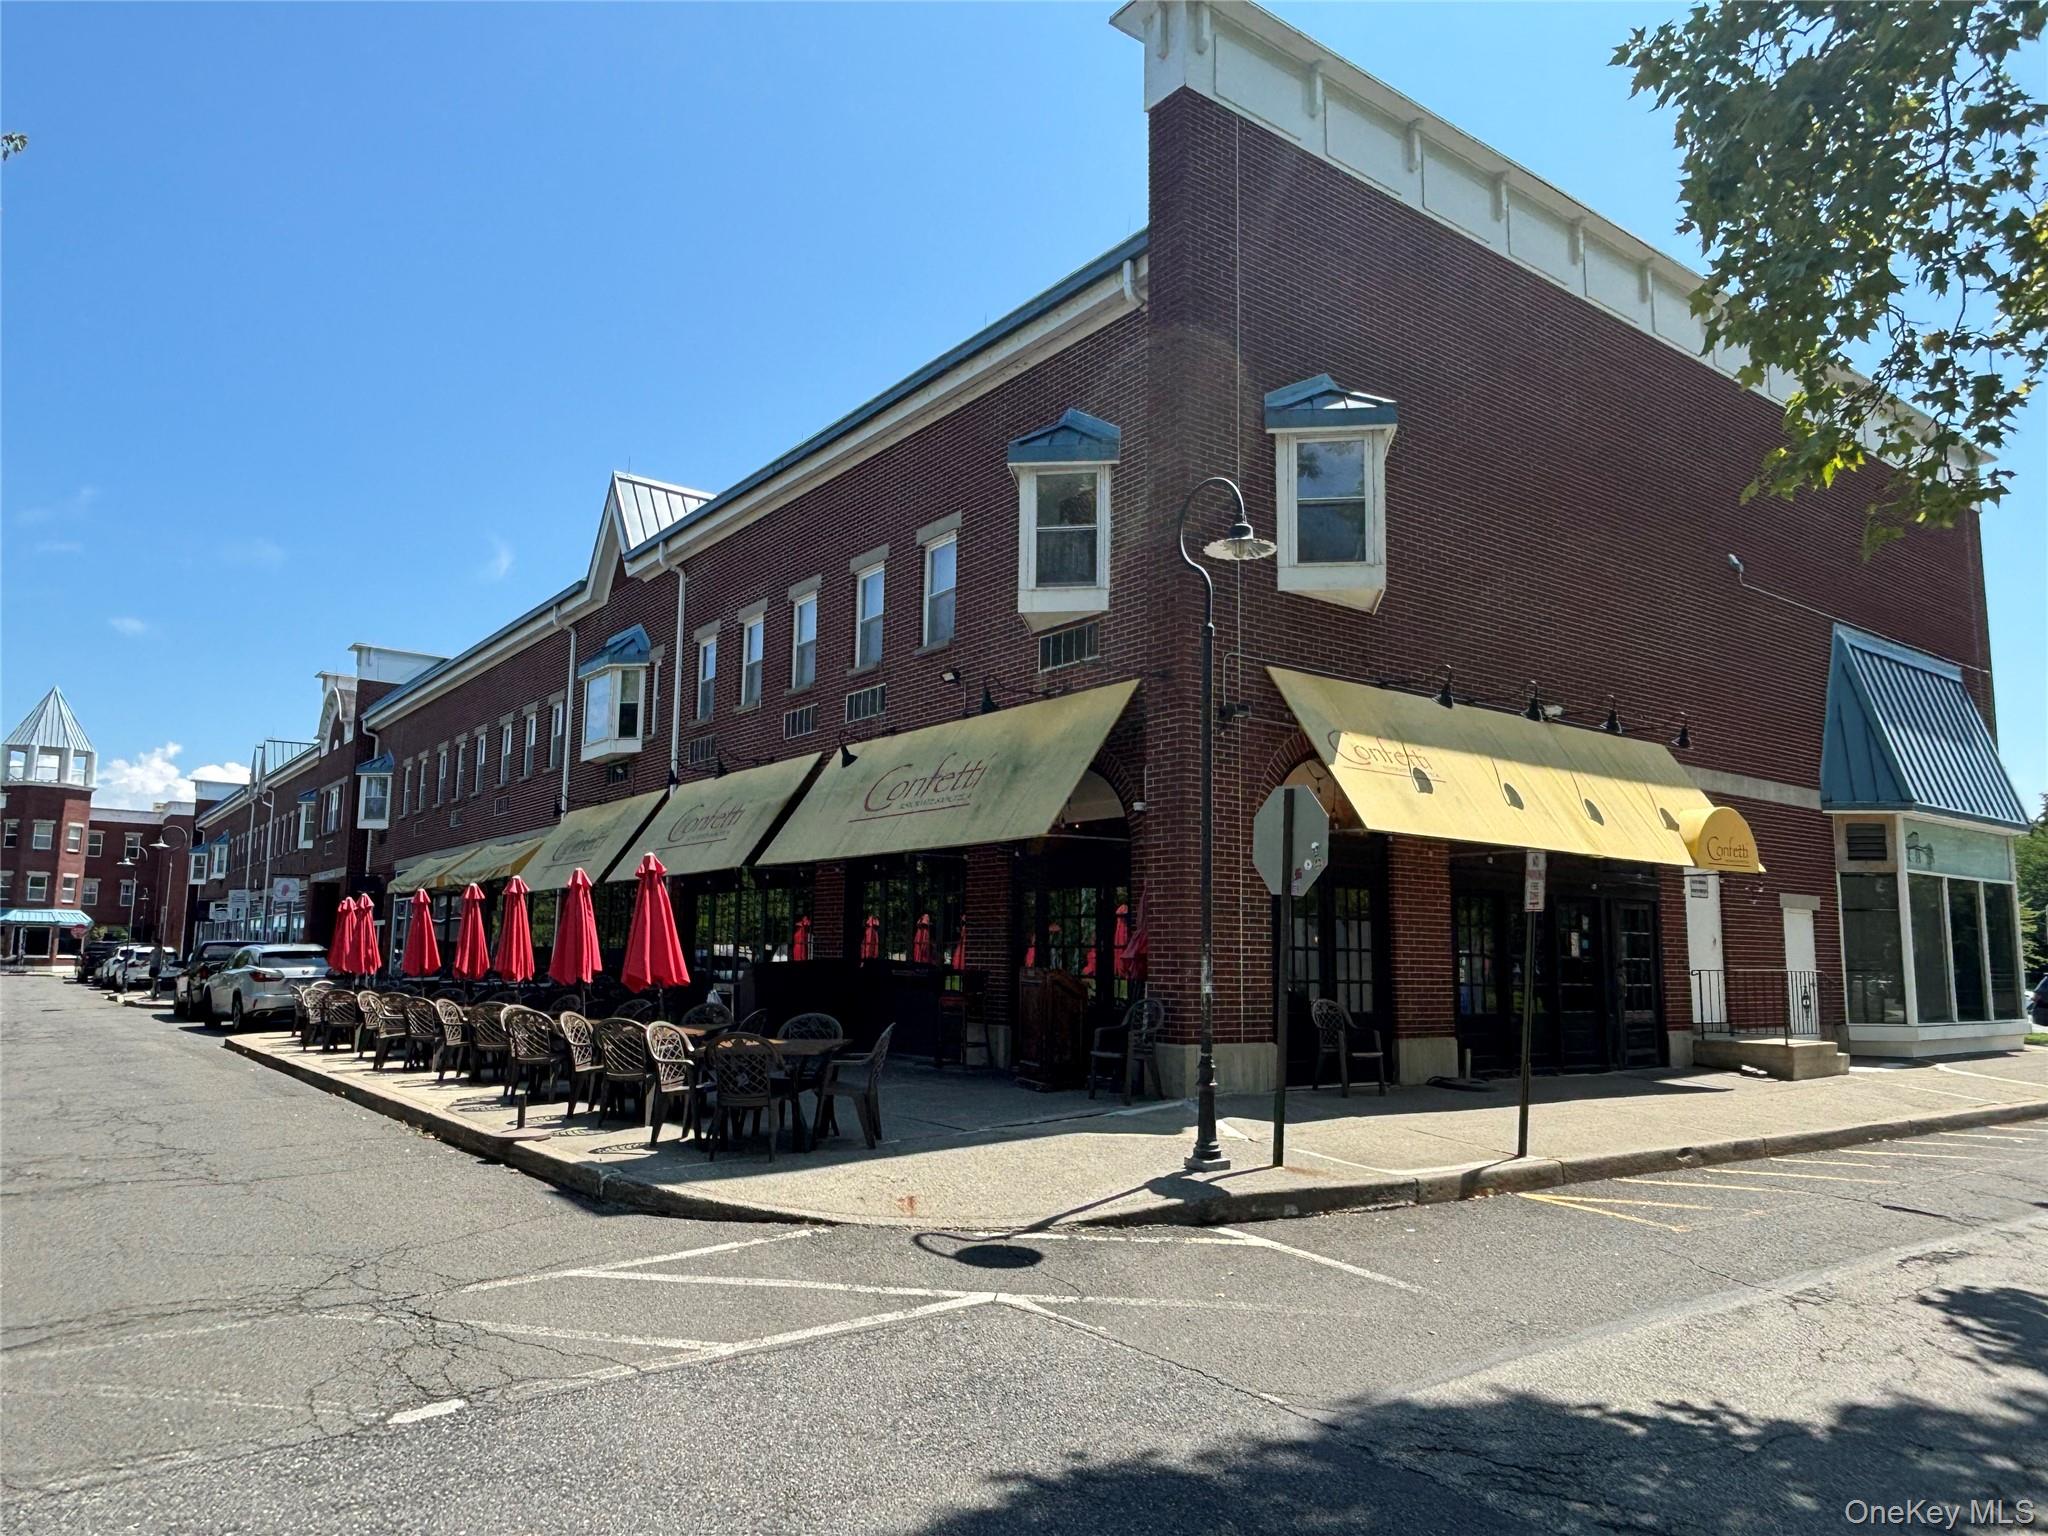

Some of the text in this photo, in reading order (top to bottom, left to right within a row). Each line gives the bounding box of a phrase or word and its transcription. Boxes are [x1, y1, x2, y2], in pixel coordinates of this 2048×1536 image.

[1327, 730, 1434, 770] Confetti
[863, 751, 999, 812] Confetti
[667, 796, 751, 843] Confetti
[1706, 835, 1750, 861] Confetti
